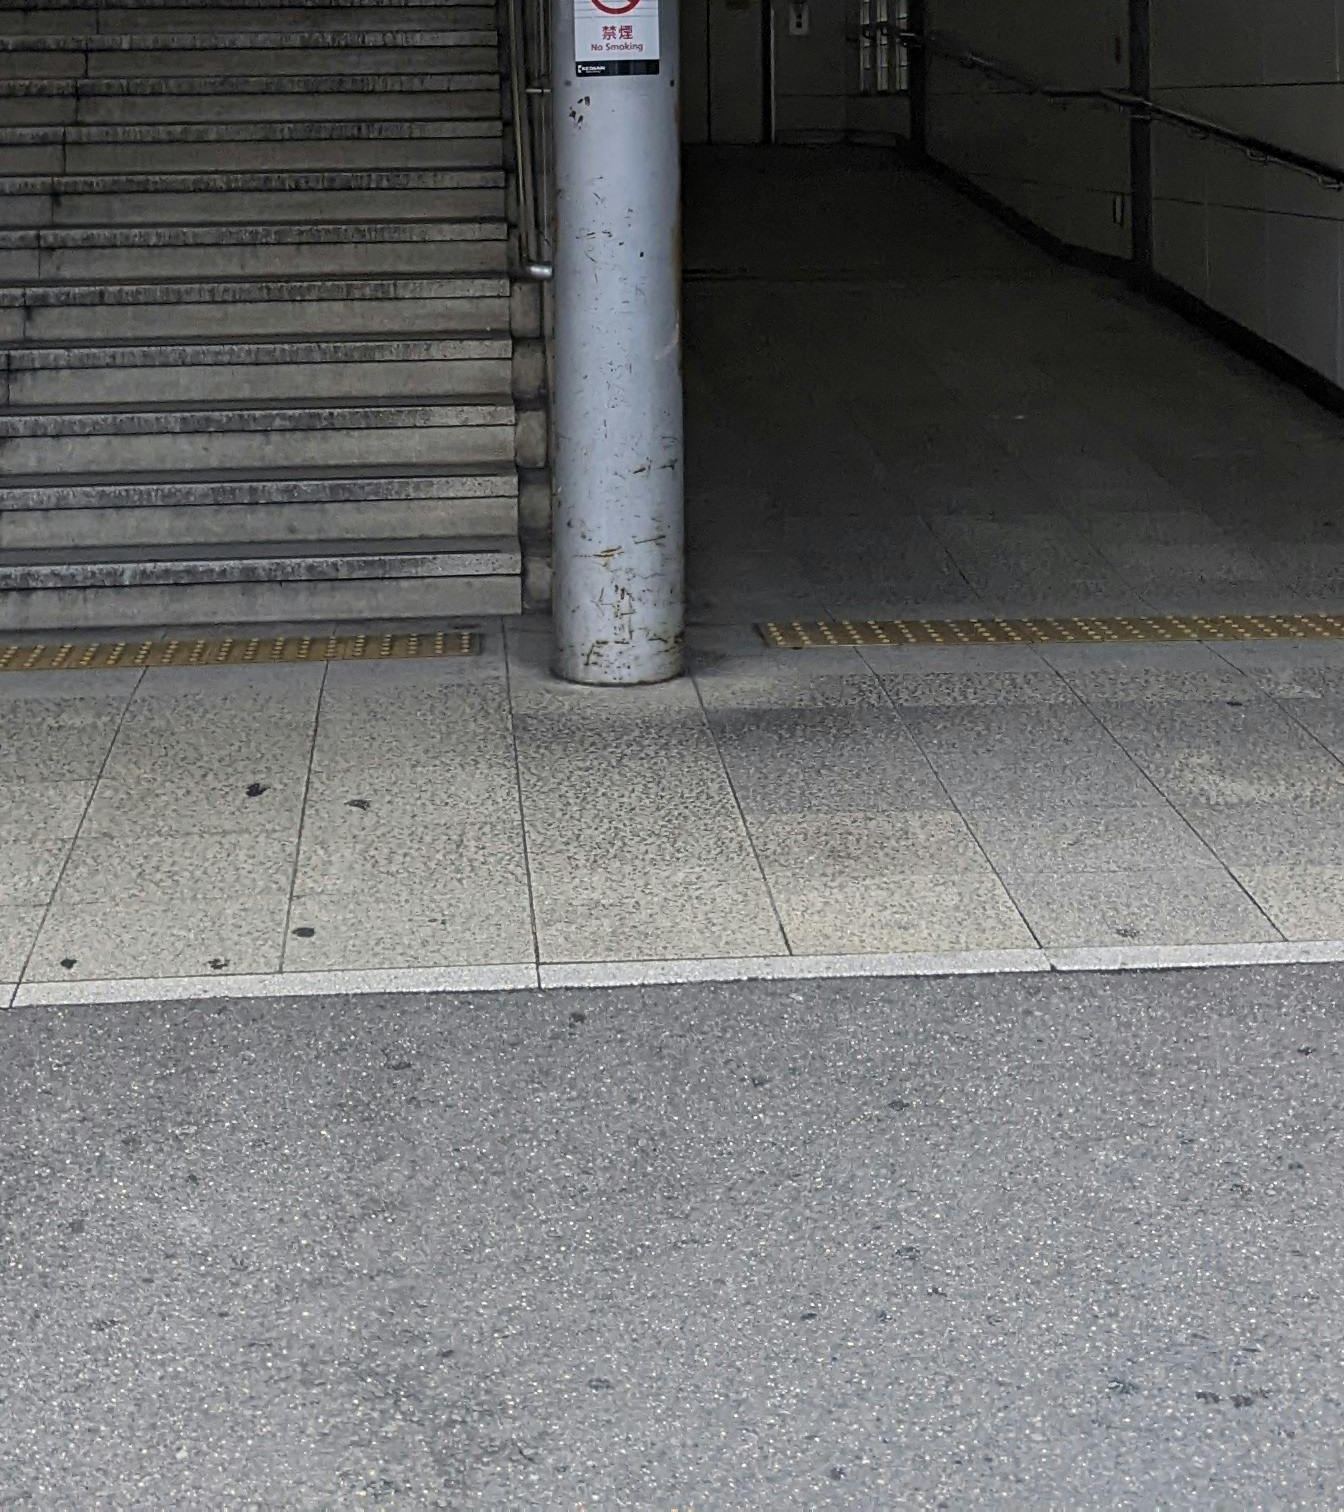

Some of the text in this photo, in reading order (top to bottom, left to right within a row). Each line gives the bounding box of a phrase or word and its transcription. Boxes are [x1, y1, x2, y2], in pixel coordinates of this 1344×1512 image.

[602, 24, 633, 40] 禁煙
[591, 42, 643, 52] No Smoking
